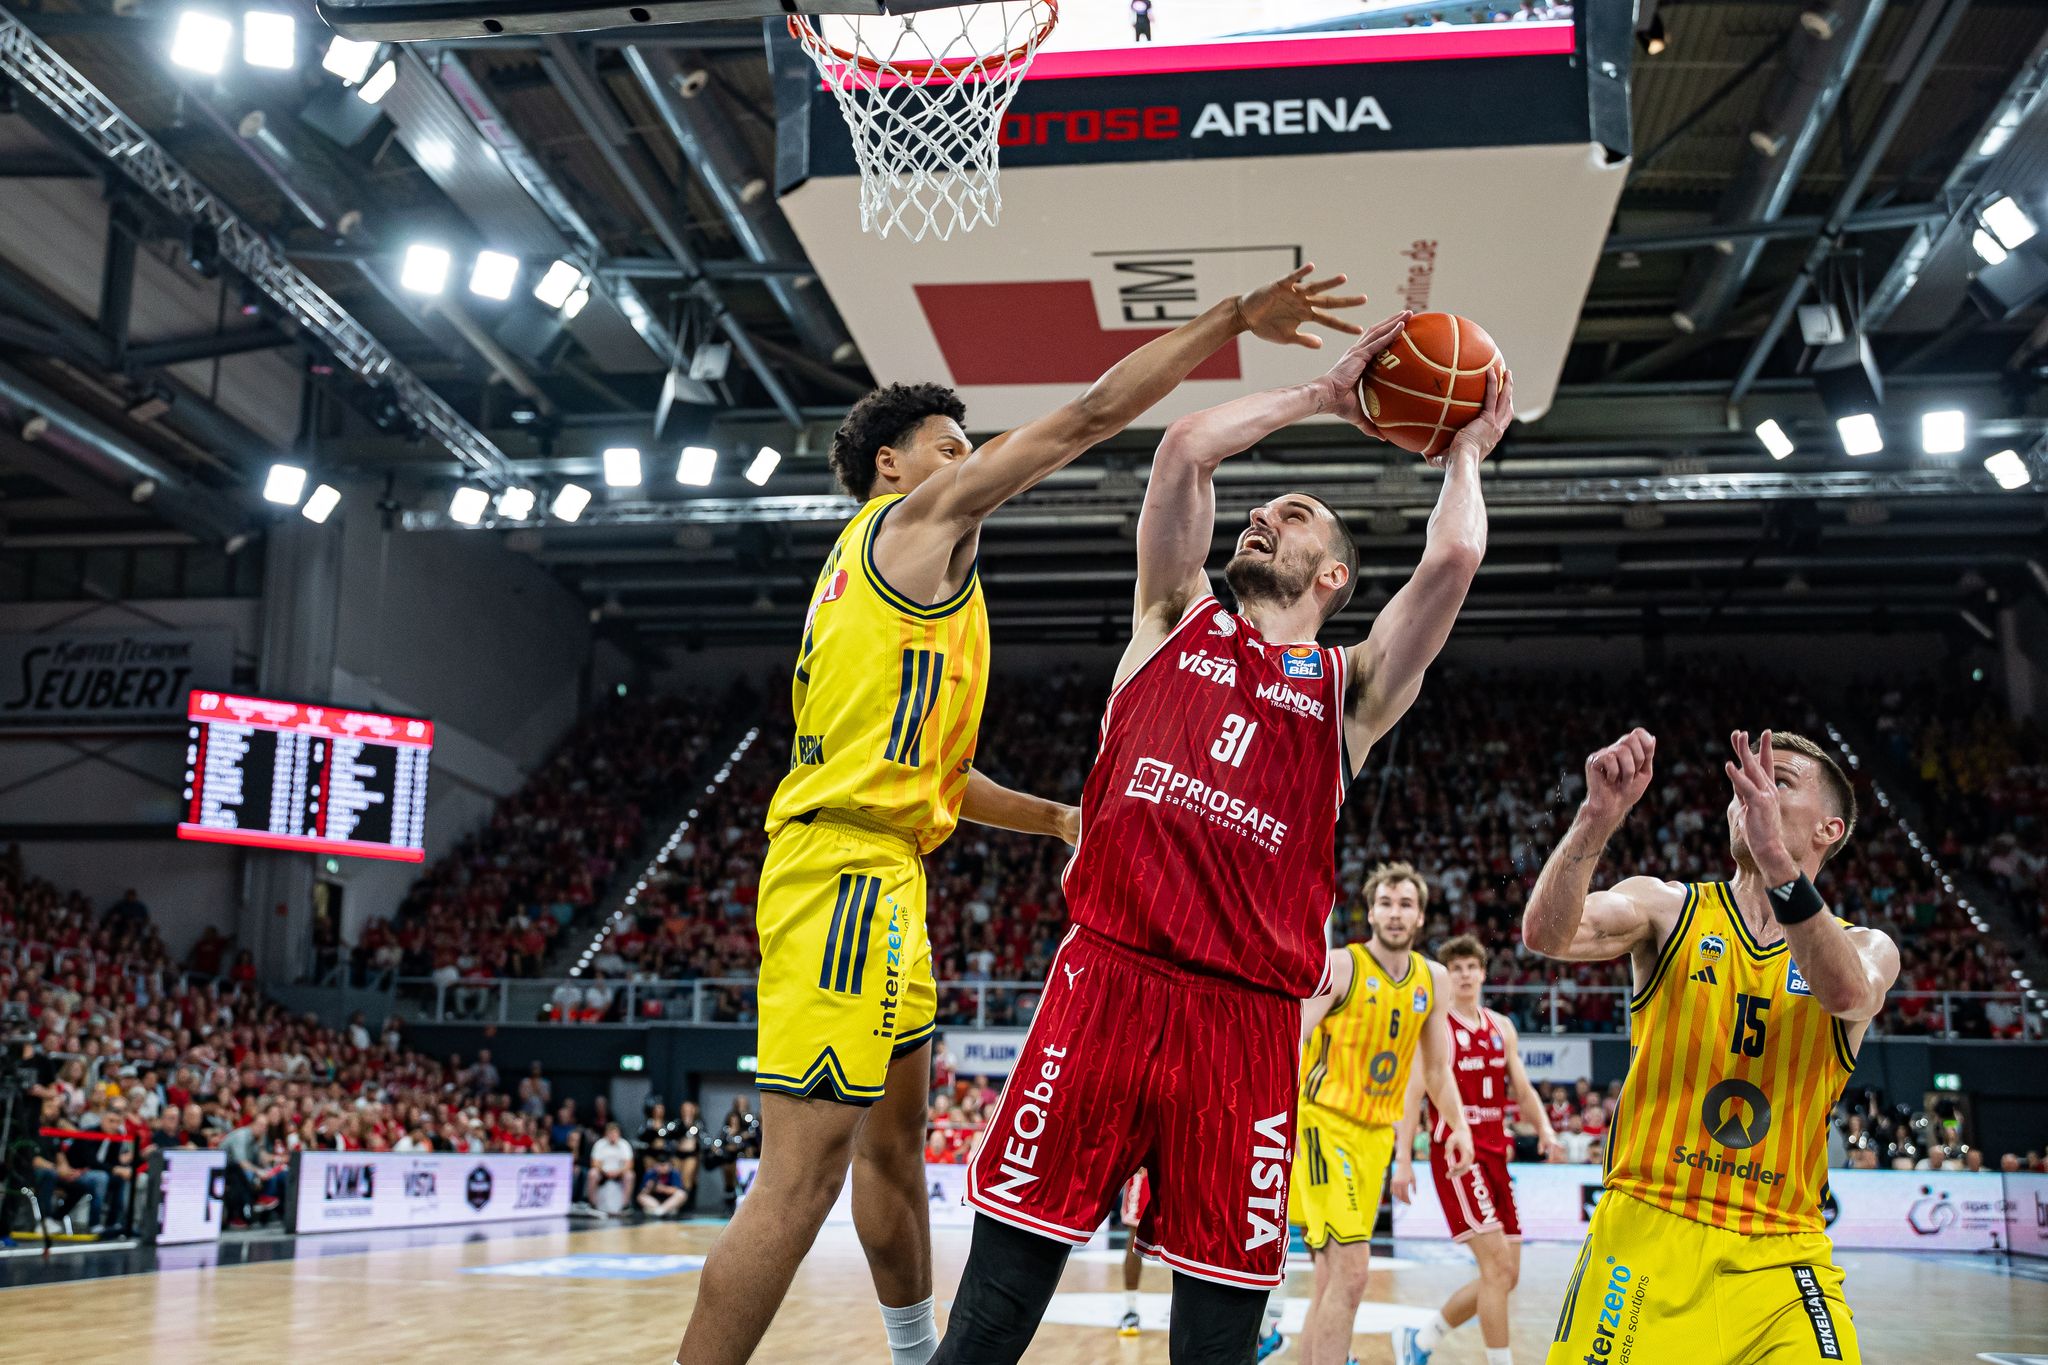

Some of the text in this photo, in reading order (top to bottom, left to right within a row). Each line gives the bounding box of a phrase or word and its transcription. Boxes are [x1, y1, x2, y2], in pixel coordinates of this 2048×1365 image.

[1191, 96, 1392, 139] ARENA
[4, 647, 192, 710] SEUBERT
[1288, 666, 1318, 676] BBL
[1255, 682, 1325, 722] MÜNDEL
[1210, 713, 1259, 768] 31
[1165, 793, 1280, 857] safety starts here!
[1169, 772, 1288, 845] PRIOSAFE
[1790, 979, 1811, 991] BB
[1390, 1009, 1400, 1039] 6
[1731, 993, 1771, 1058] 15
[1672, 1145, 1785, 1186] Schindler
[1628, 1274, 1650, 1332] solutions
